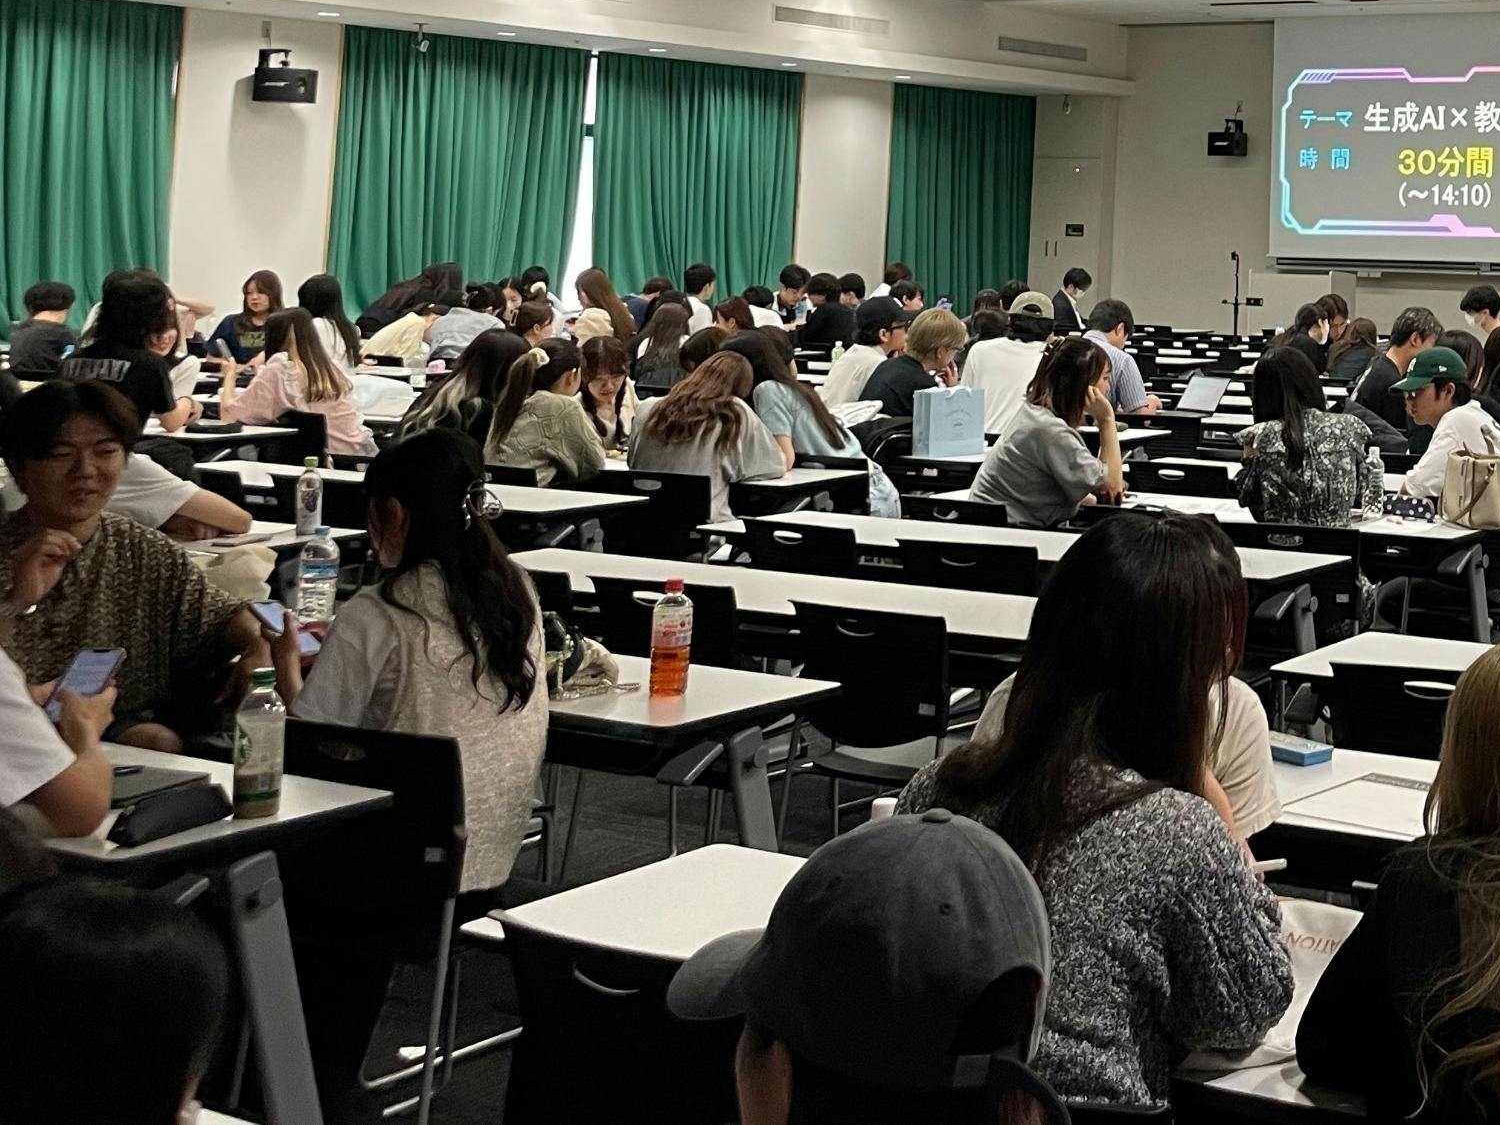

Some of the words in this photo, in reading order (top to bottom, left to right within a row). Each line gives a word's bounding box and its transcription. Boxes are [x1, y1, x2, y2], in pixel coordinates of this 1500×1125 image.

[1299, 109, 1353, 129] テーマ
[1398, 146, 1494, 178] 30分間
